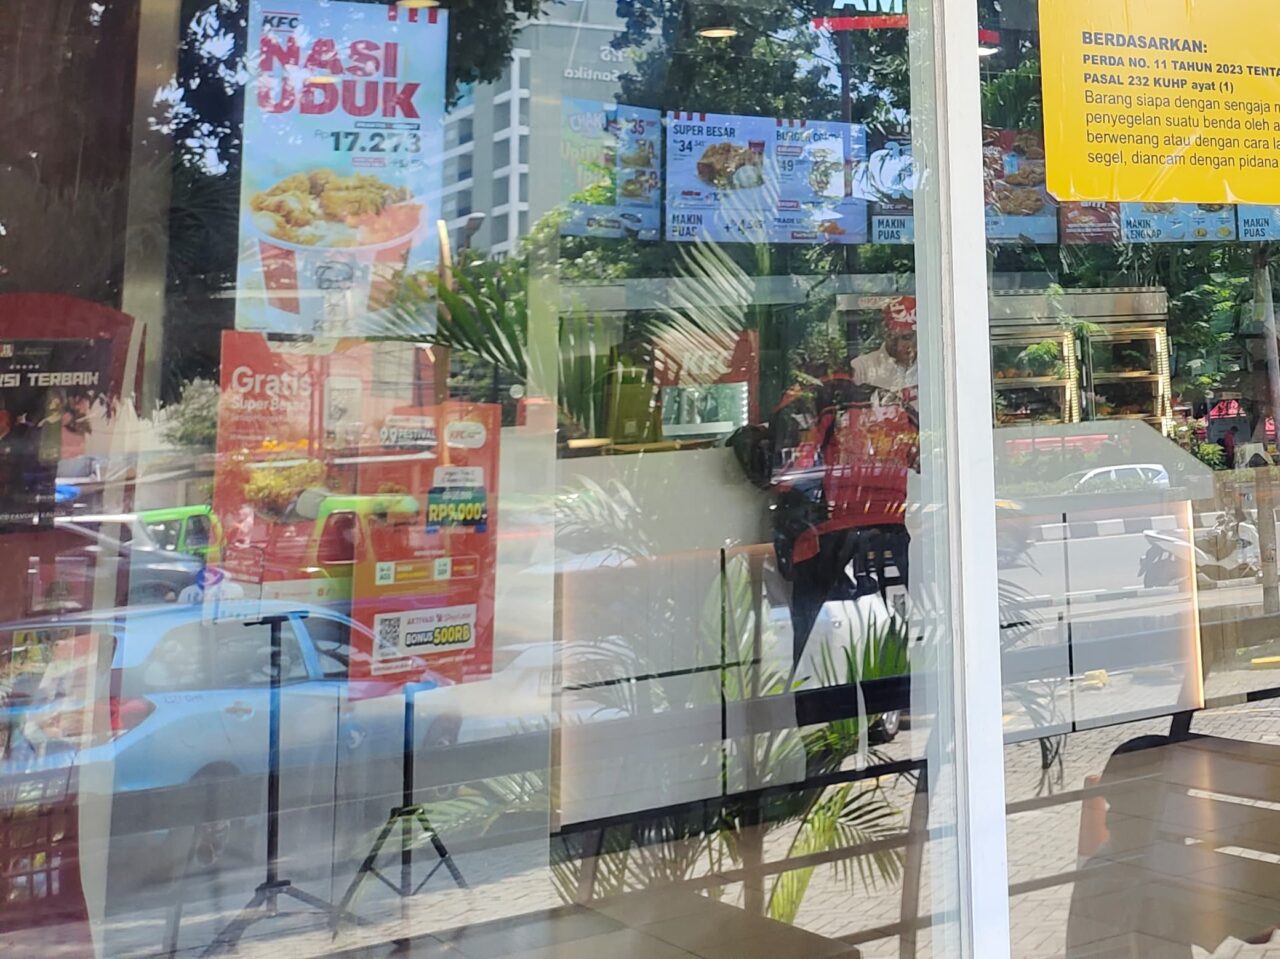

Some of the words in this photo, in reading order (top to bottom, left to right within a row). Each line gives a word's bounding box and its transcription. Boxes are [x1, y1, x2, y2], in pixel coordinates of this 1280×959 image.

[1082, 31, 1207, 53] BERDASARKAN:
[259, 35, 399, 78] NASI
[1082, 54, 1124, 66] PERDA
[1128, 57, 1149, 68] NO.
[1154, 59, 1166, 69] 11
[1171, 60, 1212, 72] TAHUN
[1215, 63, 1243, 74] 2023
[1083, 72, 1124, 84] PASAL
[1153, 76, 1187, 88] KUHP
[1191, 81, 1215, 92] ayat
[256, 76, 421, 119] UDUK
[1084, 89, 1132, 108] Barang
[1136, 93, 1170, 109] siapa
[1174, 95, 1220, 112] dengan
[1224, 99, 1270, 115] sengaja
[1085, 112, 1160, 128] penyegelan
[1165, 115, 1199, 128] suatu
[1203, 115, 1240, 129] benda
[1244, 117, 1269, 130] oleh
[673, 124, 704, 137] SUPER
[706, 126, 736, 138] BESAR
[1086, 129, 1158, 148] berwenang
[1163, 134, 1190, 147] atau
[1194, 133, 1241, 152] dengan
[1243, 138, 1269, 149] cara
[1087, 150, 1126, 166] segel,
[1131, 150, 1185, 168] diancam
[1189, 152, 1234, 169] dengan
[1238, 154, 1278, 170] pidana
[672, 213, 703, 225] MAKIN
[877, 218, 906, 230] MAKIN
[1124, 218, 1152, 230] MAKIN
[1242, 218, 1270, 229] MAKIN
[877, 229, 901, 240] PUAS
[1243, 227, 1266, 238] PUAS
[27, 371, 99, 388] TERBAIK
[231, 366, 313, 395] Gratis
